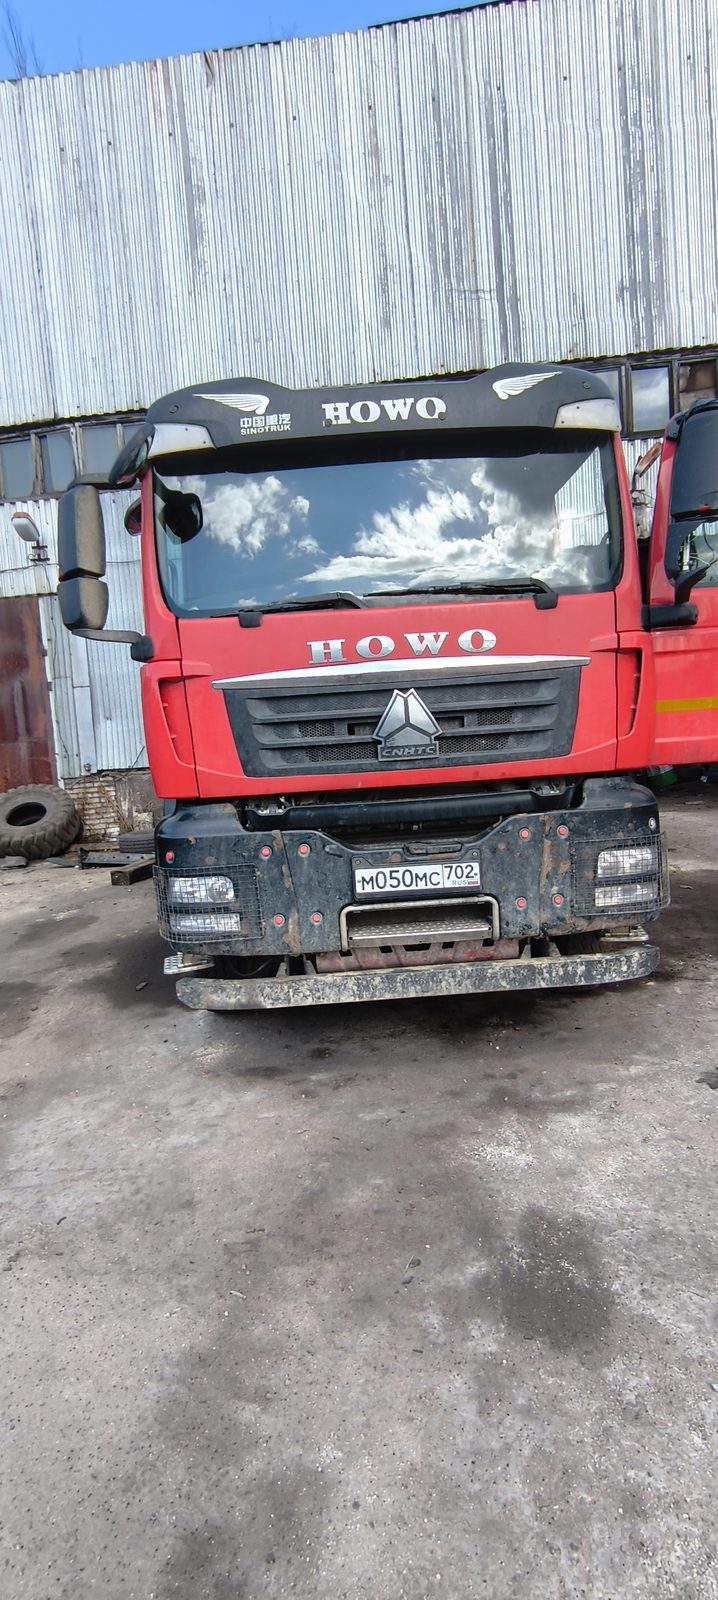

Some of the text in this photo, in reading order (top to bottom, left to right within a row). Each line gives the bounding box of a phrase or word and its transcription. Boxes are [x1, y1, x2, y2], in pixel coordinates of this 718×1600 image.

[321, 397, 447, 427] HOWO
[240, 413, 291, 428] 中国重汽
[240, 424, 291, 436] SINOTRUK
[306, 629, 497, 664] HOWO
[382, 744, 436, 757] CNHTC
[444, 864, 474, 880] 702
